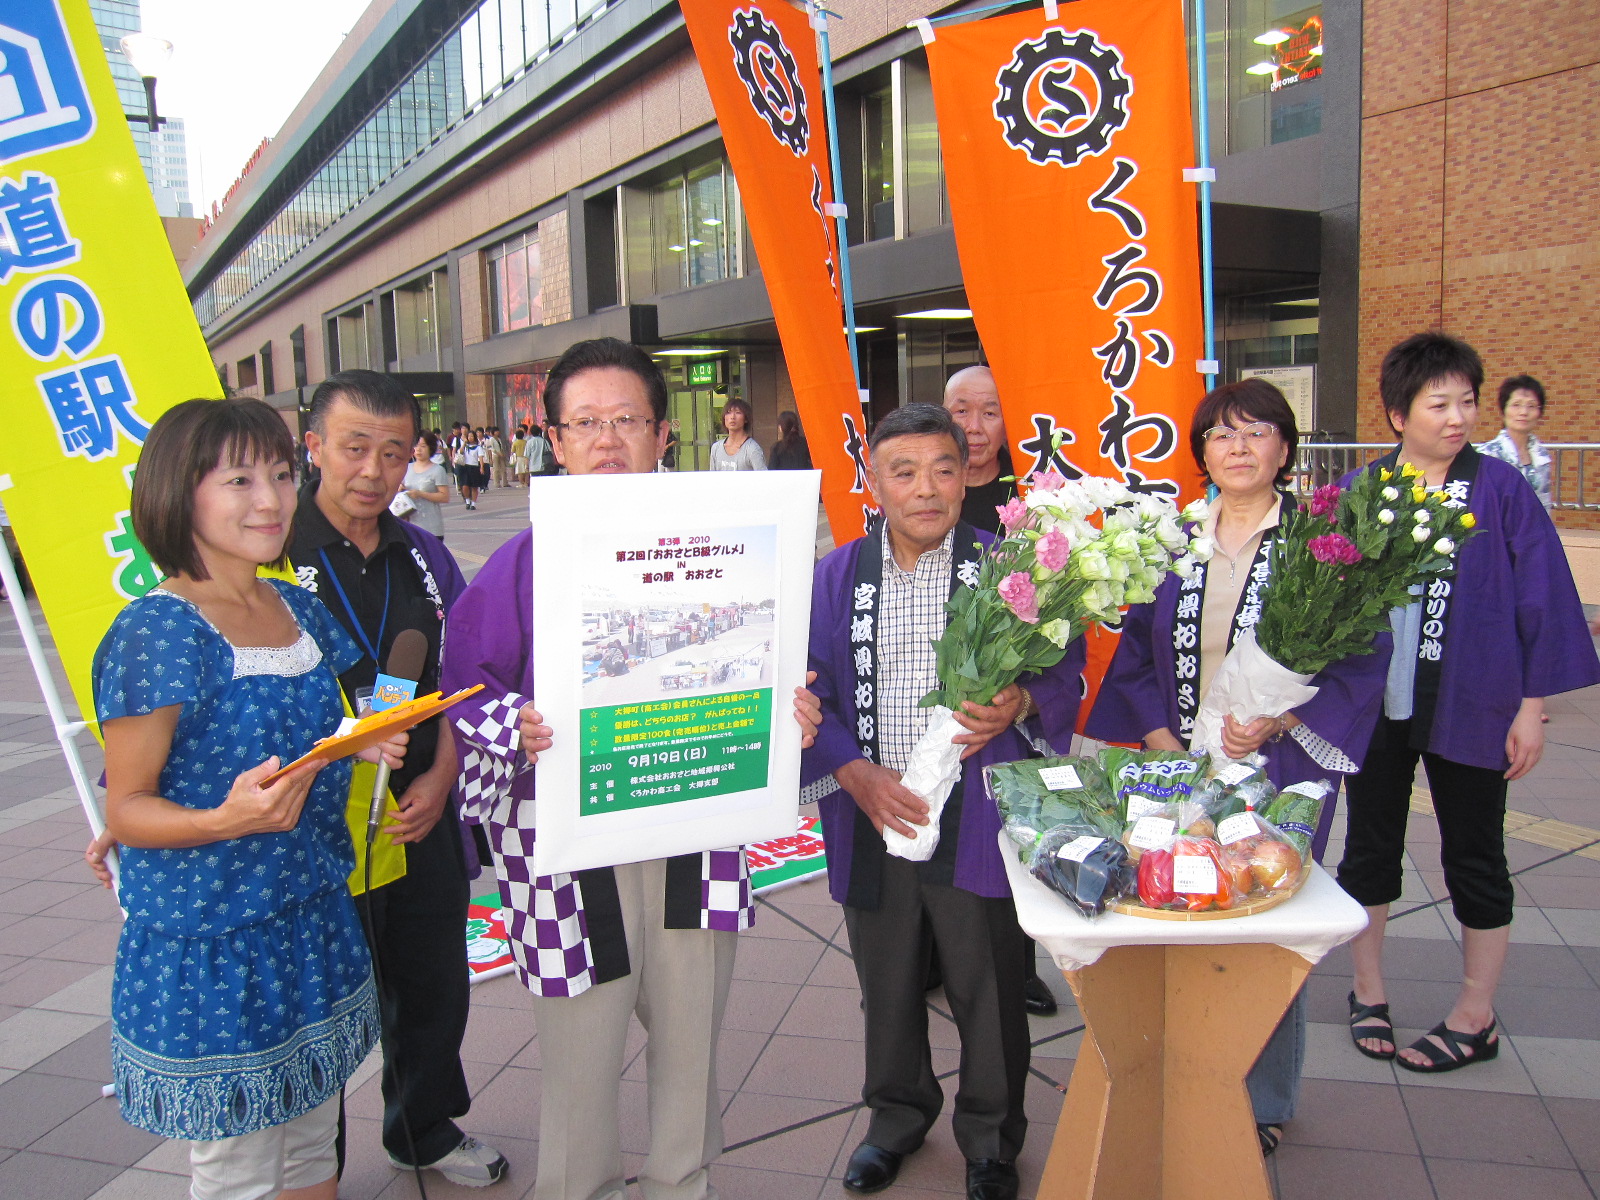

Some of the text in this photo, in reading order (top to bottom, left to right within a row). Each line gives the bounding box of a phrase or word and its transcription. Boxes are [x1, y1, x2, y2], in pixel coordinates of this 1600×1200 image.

[0, 171, 152, 458] 道の駅
[687, 535, 711, 545] 2010
[676, 561, 686, 569] IN
[642, 568, 724, 584] 道の駅 おおさと
[589, 763, 612, 773] 2010
[630, 784, 681, 798] くろかわ商工会
